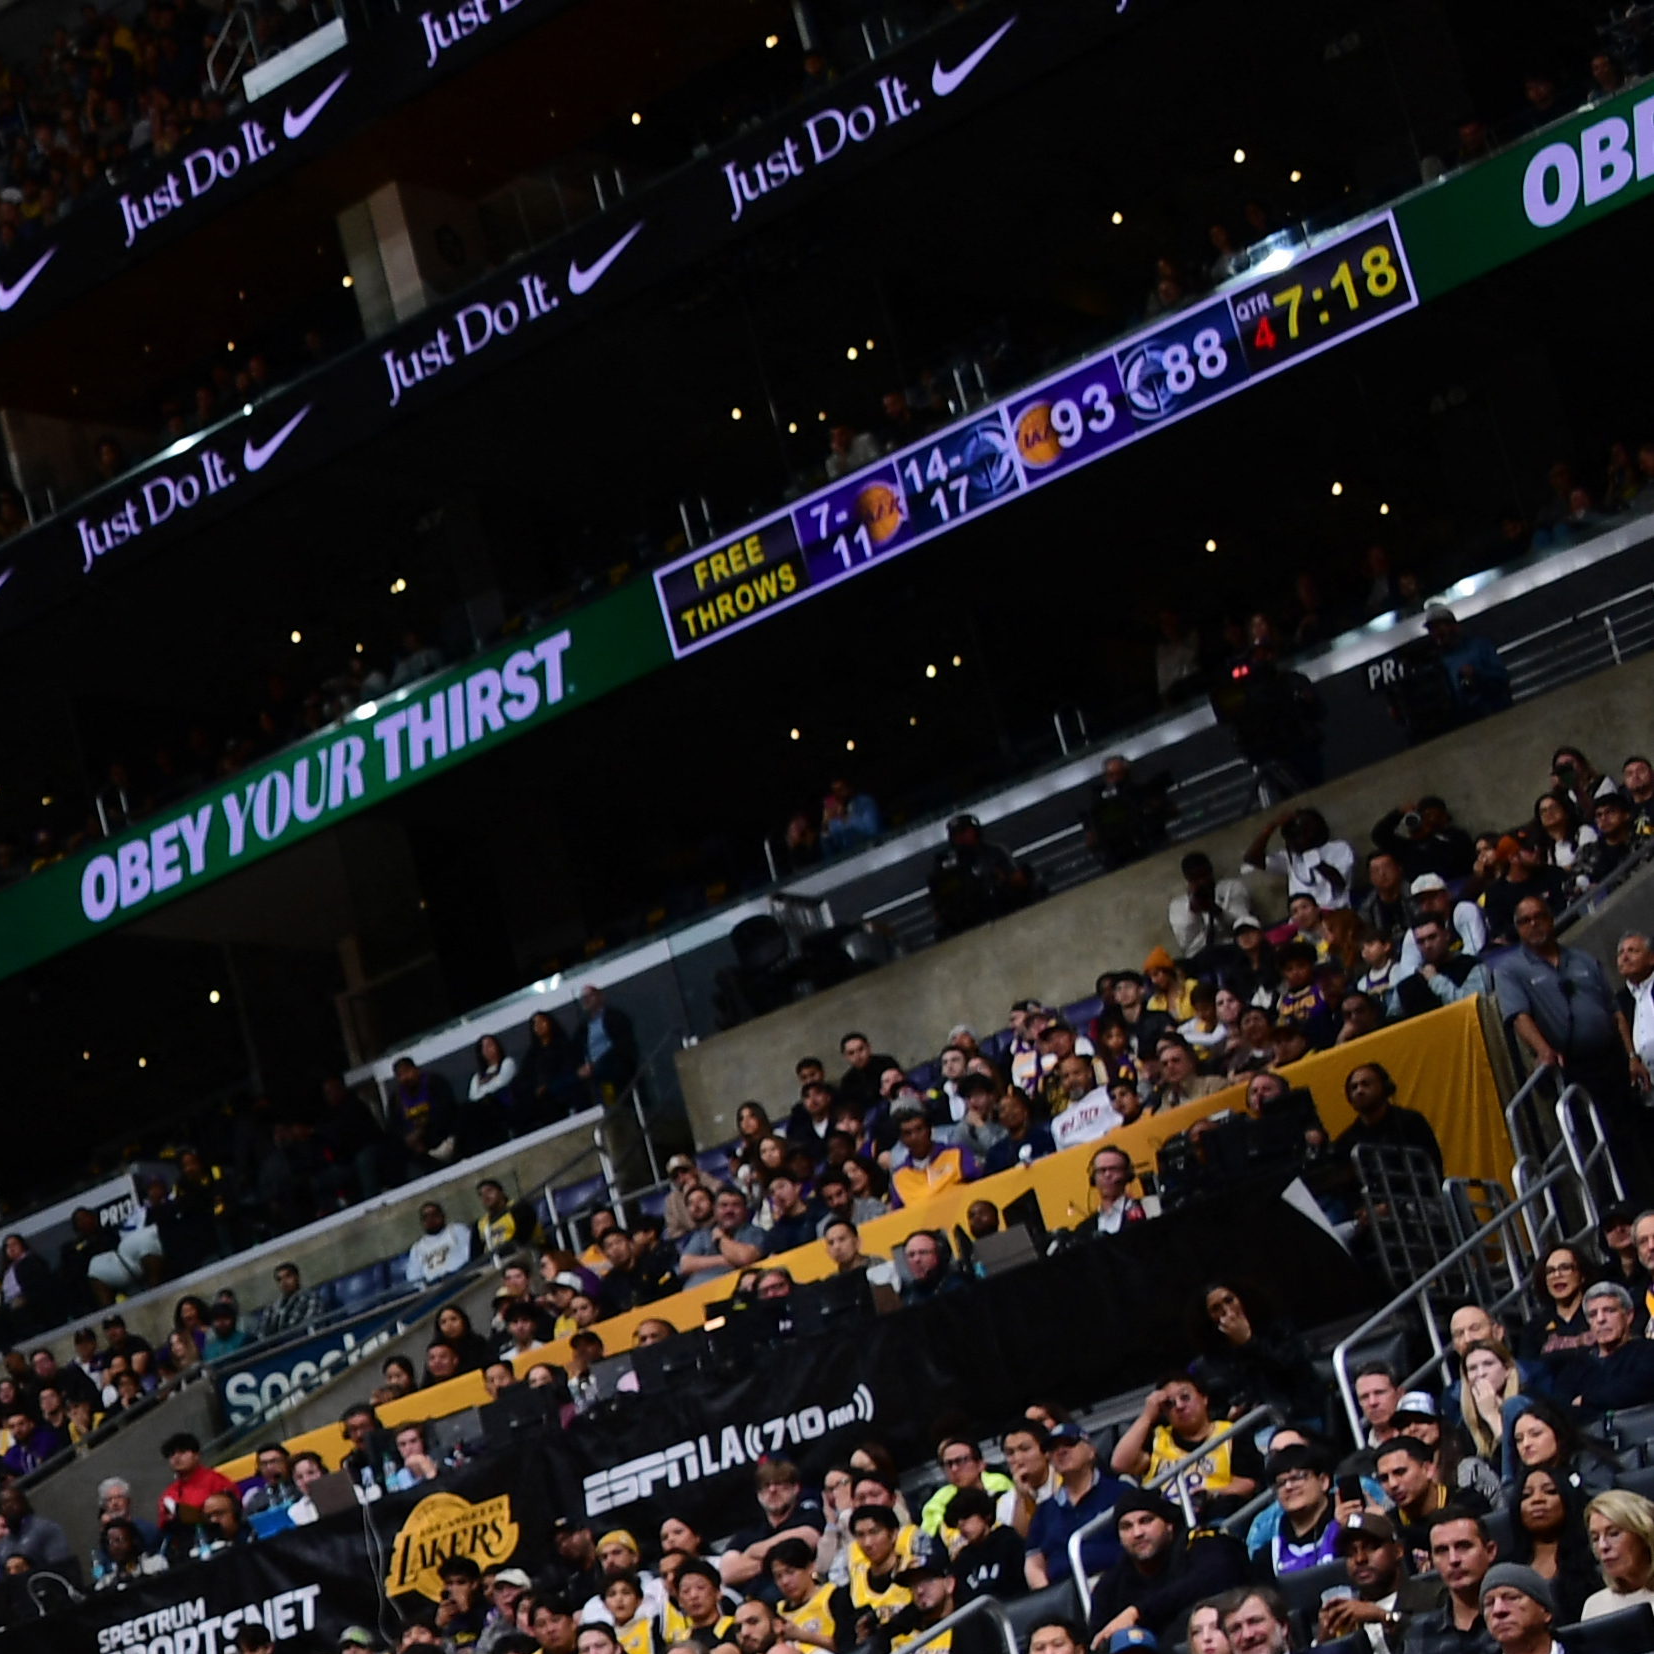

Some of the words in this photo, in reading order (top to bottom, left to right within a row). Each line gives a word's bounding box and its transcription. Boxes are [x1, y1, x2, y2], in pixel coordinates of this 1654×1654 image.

[421, 0, 490, 67] Just
[724, 138, 803, 221] Just
[805, 106, 875, 163] Do
[878, 78, 920, 124] It.
[120, 174, 182, 246] Just
[184, 146, 240, 197] Do
[241, 122, 275, 162] It.
[1236, 293, 1270, 321] QTR
[1274, 246, 1397, 338] 7:18
[384, 329, 454, 406] Just
[456, 301, 519, 354] Do
[521, 276, 558, 319] It.
[1154, 329, 1227, 394] 88
[1255, 317, 1275, 347] 4
[1051, 384, 1115, 447] 93
[78, 501, 140, 572] Just
[143, 476, 199, 525] Do
[201, 452, 235, 494] It.
[931, 476, 968, 521] 17
[694, 536, 764, 590] FREE
[834, 525, 872, 568] 11
[682, 564, 796, 637] THROWS
[82, 805, 212, 920] OBEY
[223, 736, 365, 855] YOUR
[374, 630, 570, 780] THIRST
[763, 1404, 826, 1451] 710
[399, 1516, 520, 1587] LAKERS
[96, 1596, 207, 1654] SPECTRUM
